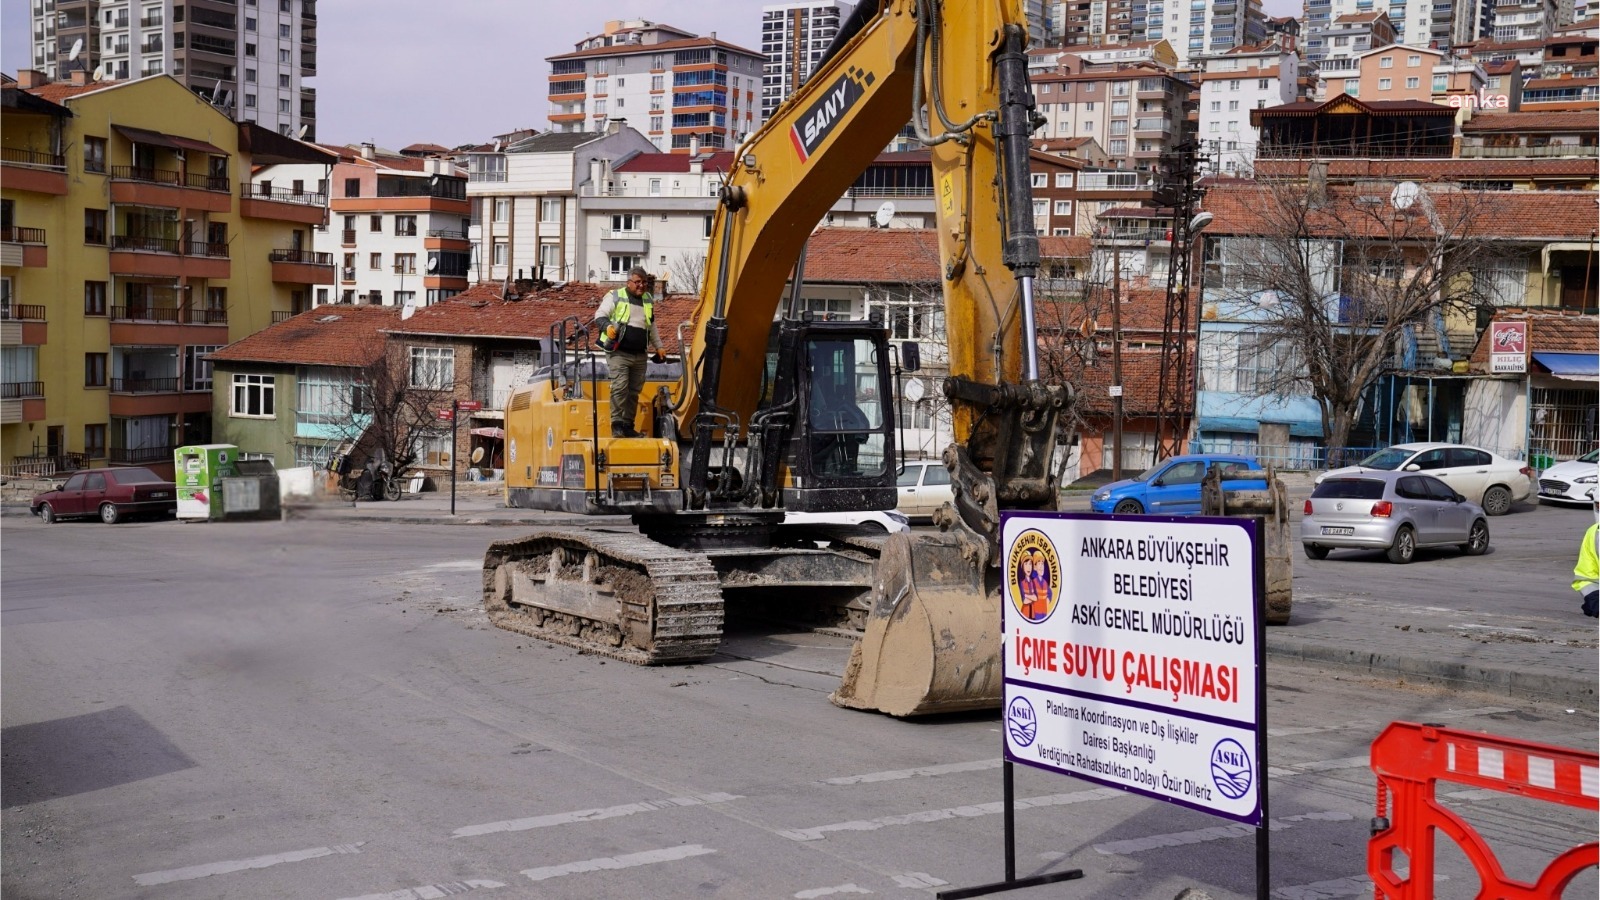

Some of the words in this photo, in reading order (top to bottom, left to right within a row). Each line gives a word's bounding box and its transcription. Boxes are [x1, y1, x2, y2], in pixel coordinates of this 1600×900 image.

[804, 79, 847, 148] SANY
[1081, 537, 1135, 560] ANKARA
[1138, 535, 1229, 569] BÜYÜKŞEHİR
[1114, 571, 1193, 601] BELEDİYESİ
[1071, 601, 1100, 627] ASKİ
[1104, 607, 1148, 633] GENEL
[1152, 608, 1244, 645] MÜDÜRLÜĞÜ
[1016, 628, 1057, 675] İÇME
[1063, 642, 1115, 682] SUYU
[1122, 651, 1238, 703] ÇALIŞMASI
[1010, 705, 1031, 720] ASKİ
[1046, 700, 1079, 720] Planlama
[1081, 706, 1137, 733] Koordinasyon
[1140, 721, 1149, 734] ve
[1151, 720, 1165, 741] Dış
[1167, 719, 1198, 745] İlişkiler
[1083, 730, 1110, 750] Dairesi
[1112, 737, 1156, 764] Başkanlığı
[1215, 749, 1244, 768] ASKİ
[1037, 743, 1075, 766] Verdiğimiz
[1076, 753, 1131, 780] Rahatsızlıktan
[1134, 766, 1159, 790] Dolayı
[1162, 770, 1182, 792] Özür
[1184, 779, 1211, 801] Dileriz
